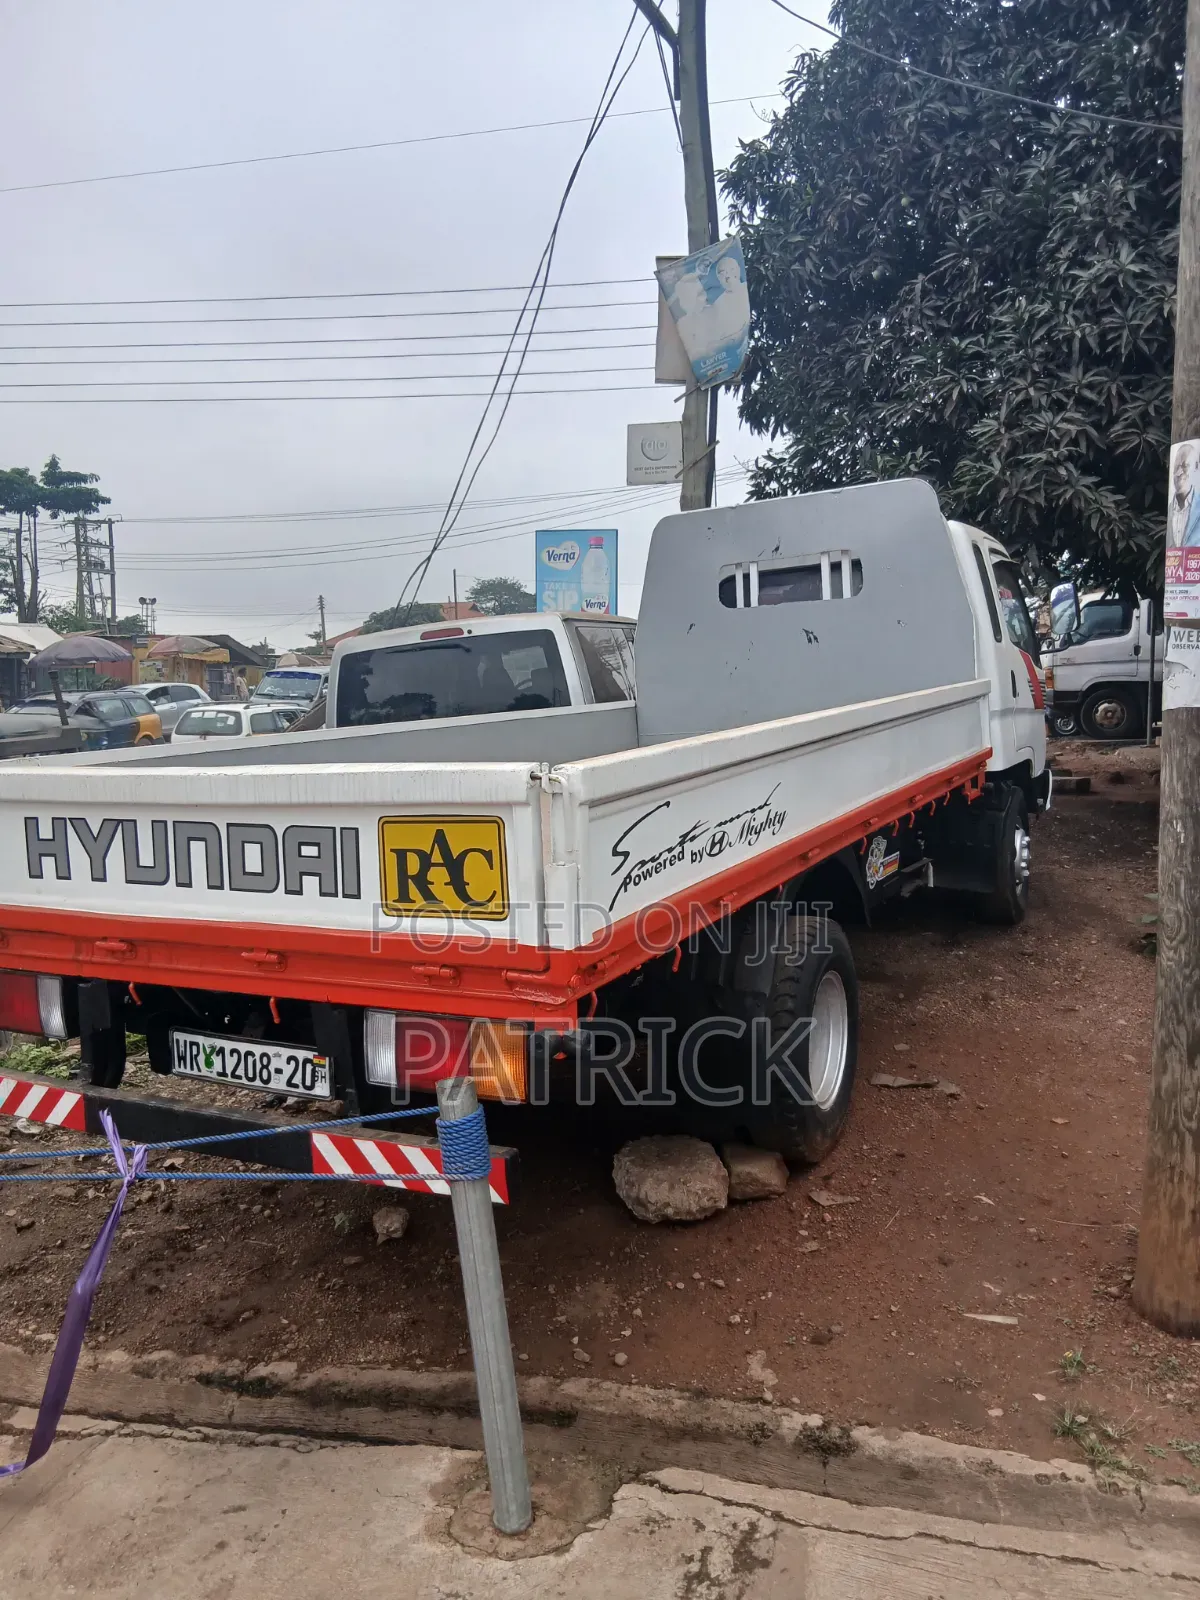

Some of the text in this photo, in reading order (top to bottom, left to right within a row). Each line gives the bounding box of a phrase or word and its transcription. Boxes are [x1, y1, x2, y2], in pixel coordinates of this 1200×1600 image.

[546, 549, 576, 563] Verna
[543, 590, 579, 612] SIP
[585, 599, 606, 610] Verna
[24, 815, 497, 907] HYUNDAI RAC
[623, 846, 685, 893] Powered
[690, 847, 705, 865] by
[728, 809, 788, 848] Mighty
[175, 1038, 202, 1073] WR
